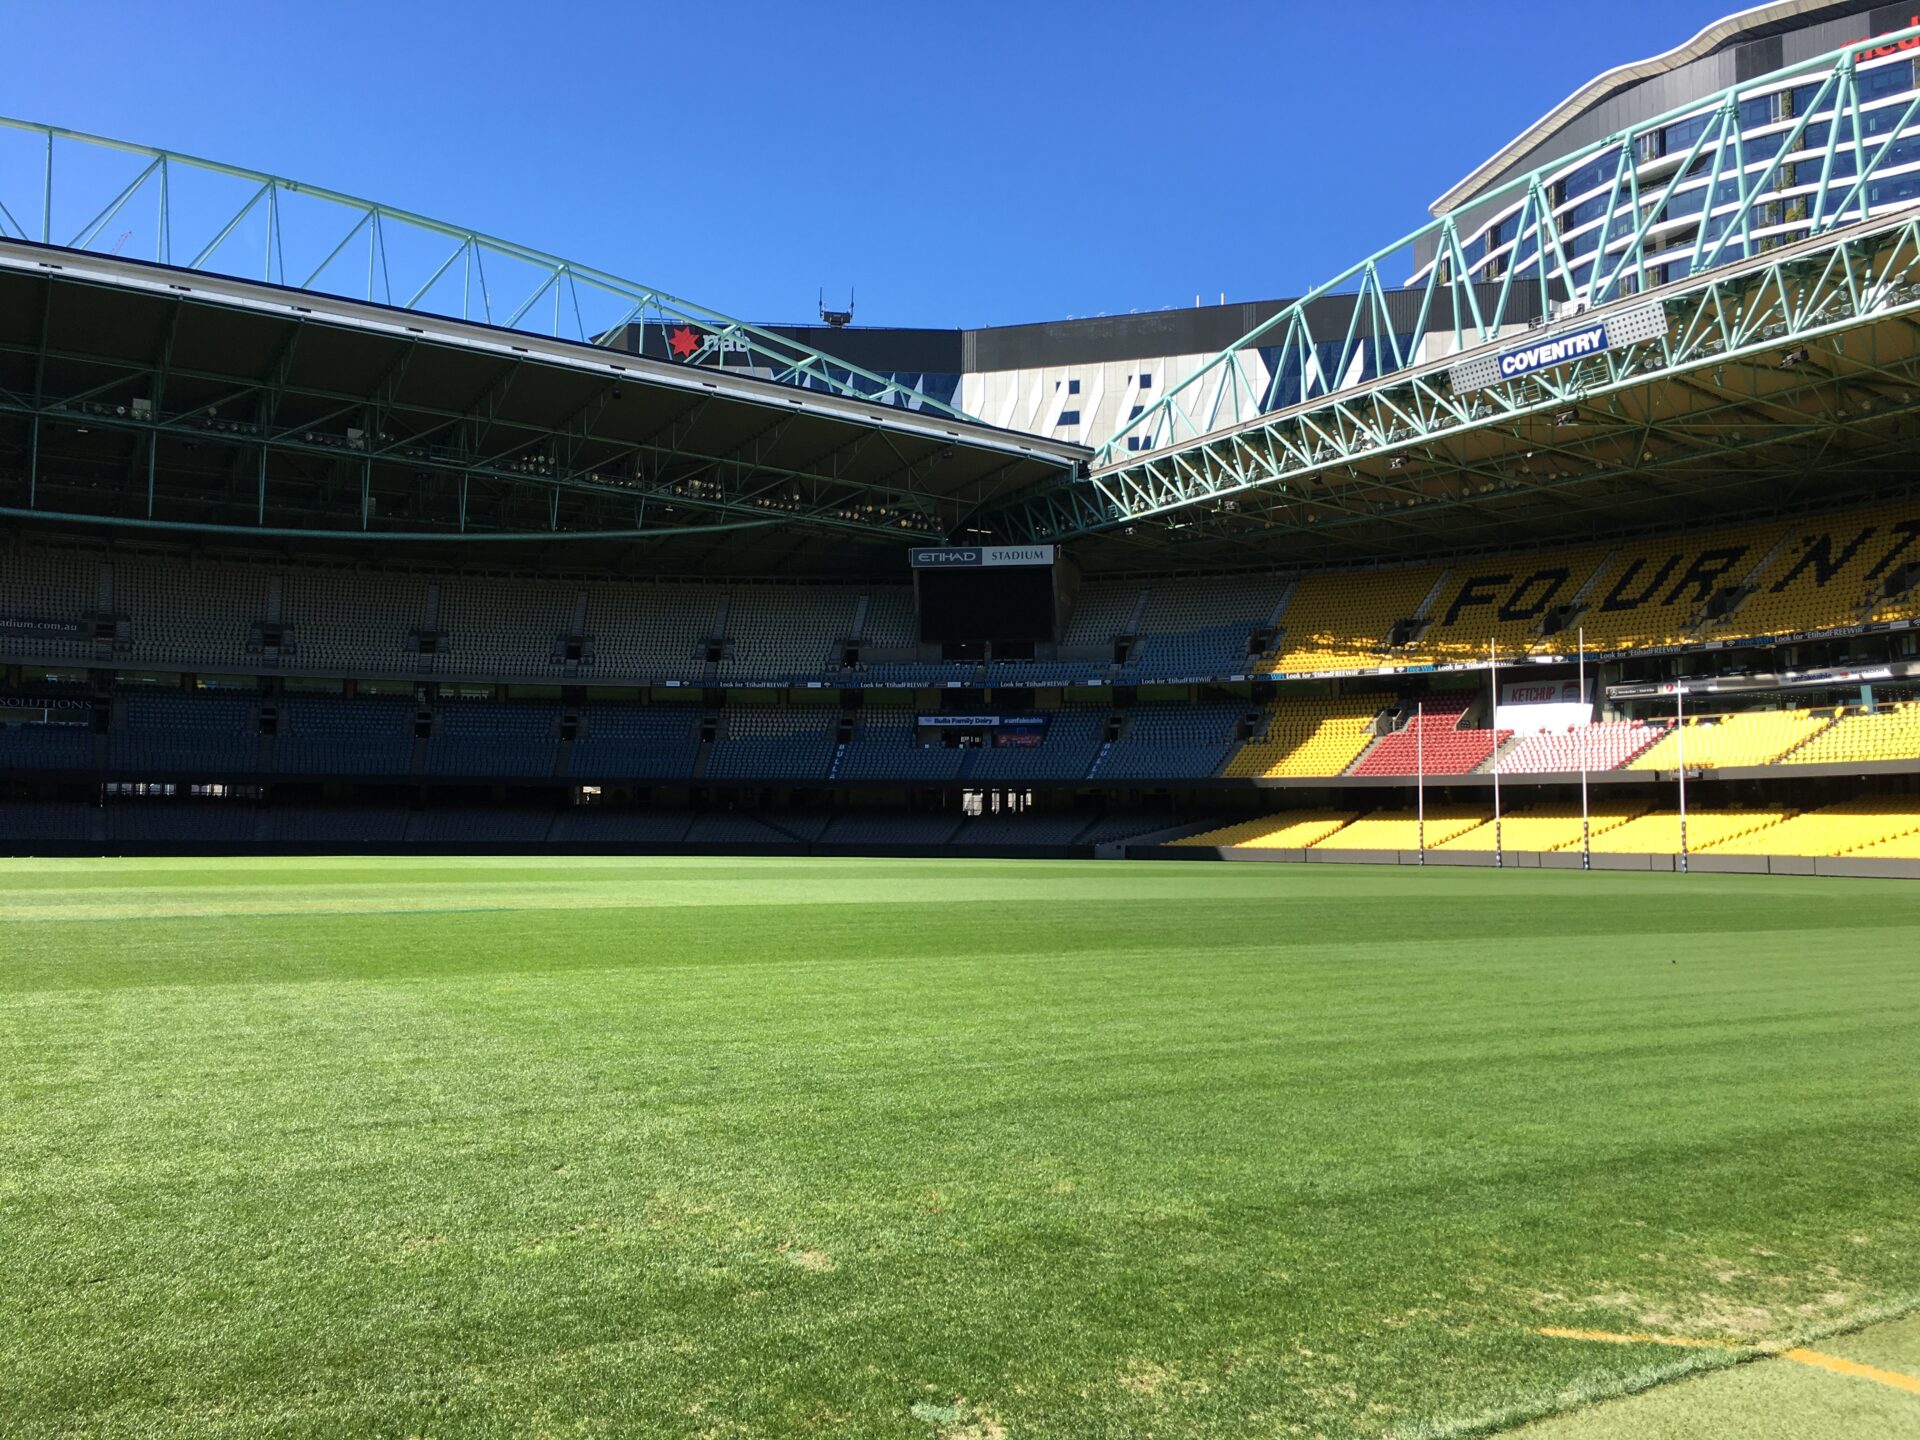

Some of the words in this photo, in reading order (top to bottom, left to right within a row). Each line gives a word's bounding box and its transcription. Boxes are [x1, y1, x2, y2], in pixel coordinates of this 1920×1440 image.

[703, 330, 751, 352] nab
[1502, 328, 1603, 374] COVENTRY
[918, 552, 976, 563] ETIHAD
[991, 550, 1044, 561] STADIUM
[1443, 544, 1750, 627] FOUR
[0, 618, 78, 632] adium.com.au
[1774, 634, 1791, 643] Look
[1793, 633, 1804, 641] for
[1600, 652, 1616, 660] Look
[1617, 650, 1627, 659] for
[1437, 664, 1453, 672] Look
[1455, 663, 1464, 671] for
[1157, 677, 1165, 685] for
[1511, 687, 1556, 702] KETCHUP
[0, 697, 93, 711] SOLUTIONS
[934, 717, 951, 725] Bulla
[951, 717, 974, 726] Family
[975, 717, 993, 726] Dairy
